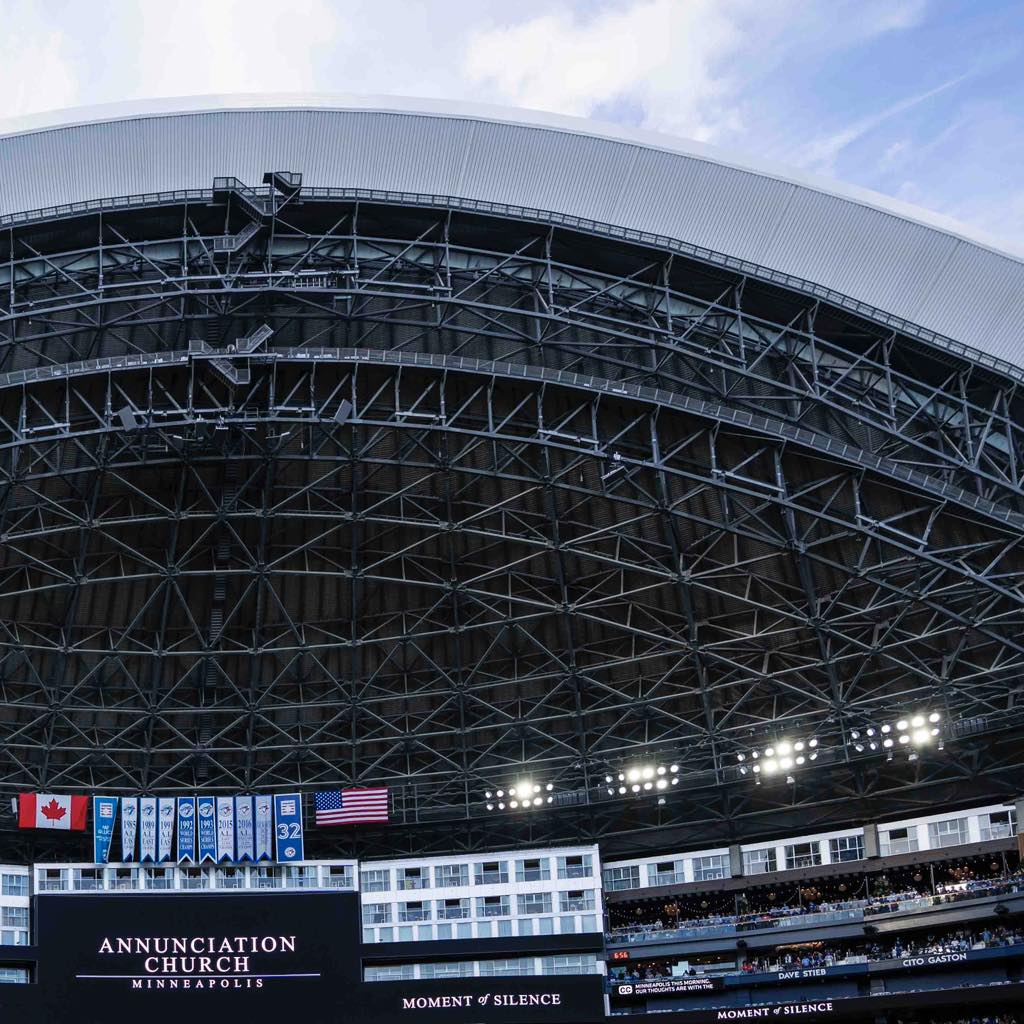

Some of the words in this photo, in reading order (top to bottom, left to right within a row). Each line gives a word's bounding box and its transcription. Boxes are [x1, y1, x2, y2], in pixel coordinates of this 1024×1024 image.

[277, 822, 301, 839] 32
[98, 936, 296, 954] ANNUNCIATION
[144, 956, 251, 973] CHURCH
[902, 958, 925, 967] CITO
[927, 953, 968, 965] GASTON
[778, 970, 800, 980] DAVE
[802, 968, 827, 978] STIEB
[131, 979, 264, 989] MINNEAPOLIS
[619, 986, 632, 994] CC
[635, 981, 670, 989] MINNEAPOLIS
[402, 995, 473, 1009] MOMENT
[478, 993, 491, 1006] of
[494, 993, 561, 1006] SILENCE
[717, 1007, 770, 1020] MOMENT
[773, 1006, 782, 1015] of
[784, 1002, 833, 1015] SILENCE
